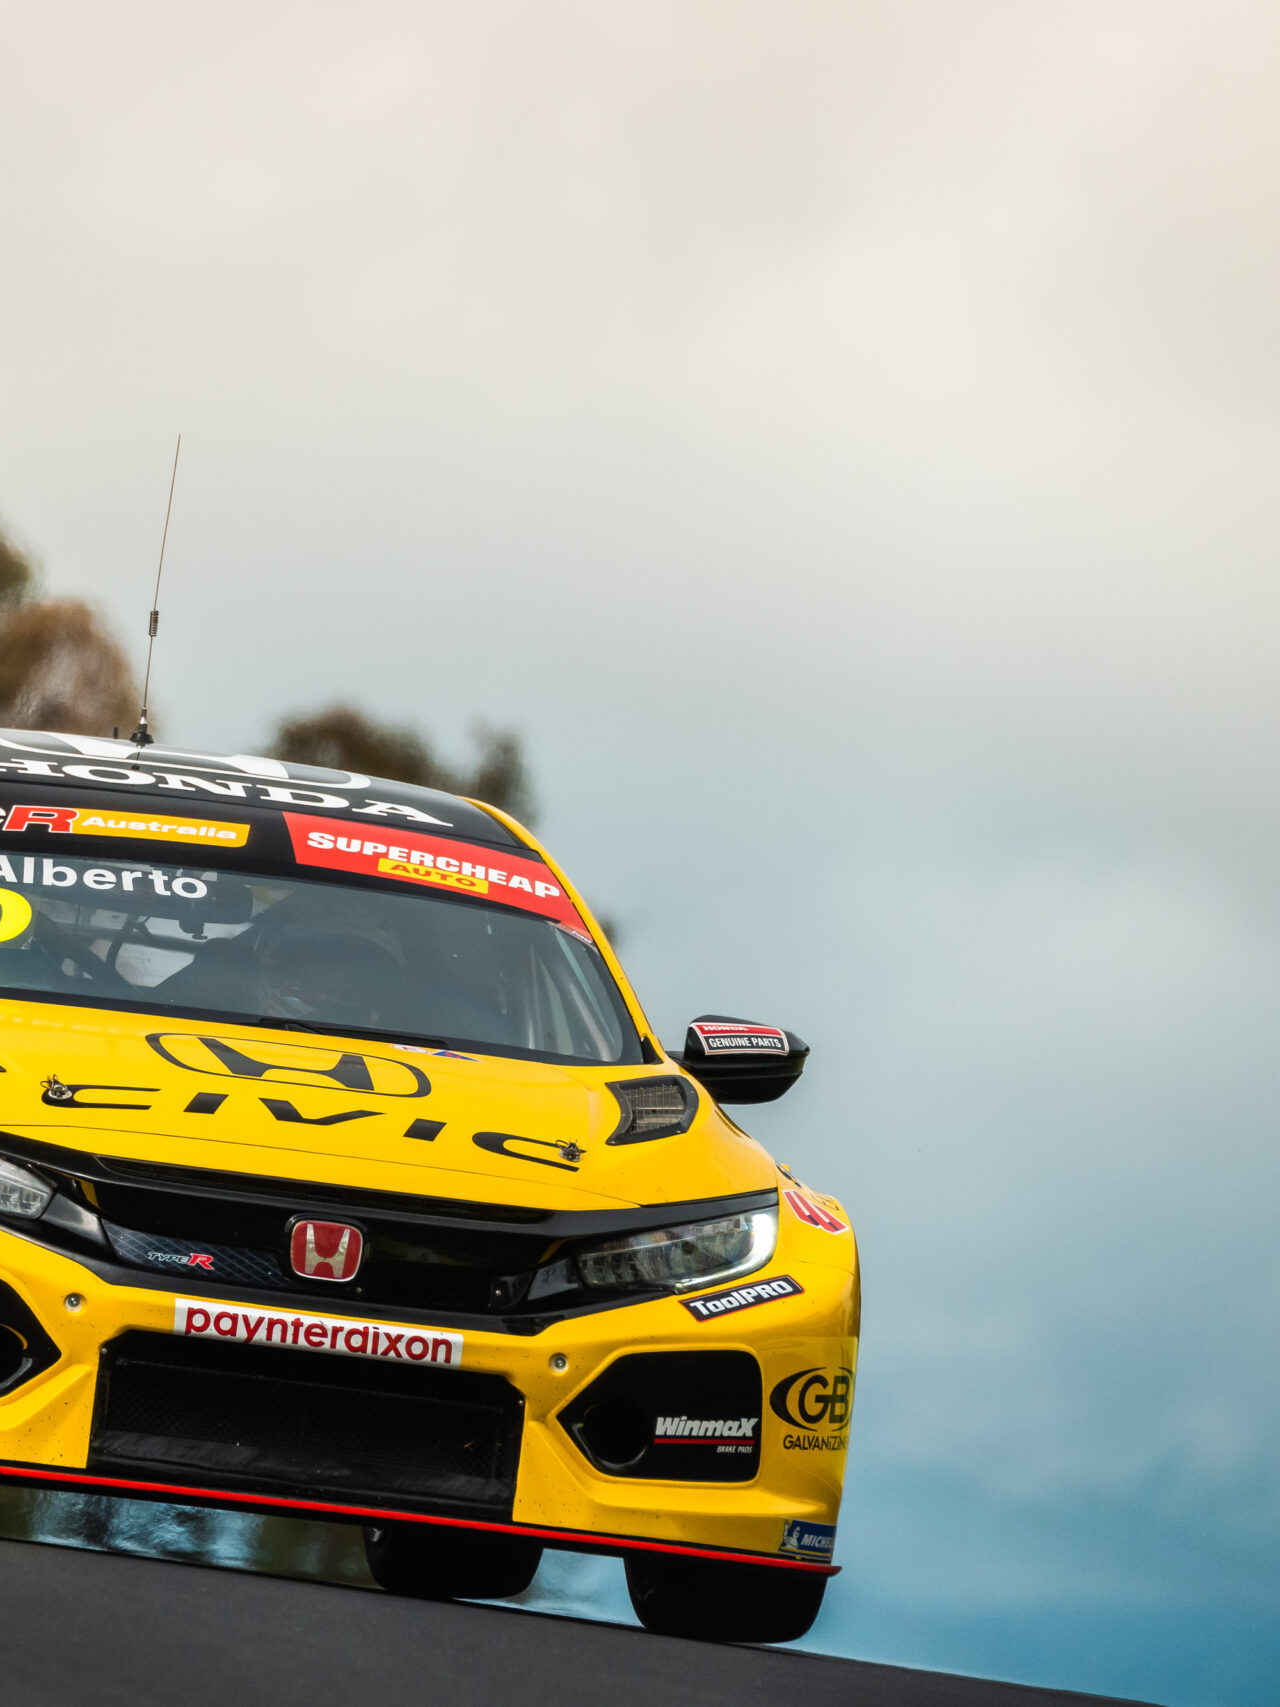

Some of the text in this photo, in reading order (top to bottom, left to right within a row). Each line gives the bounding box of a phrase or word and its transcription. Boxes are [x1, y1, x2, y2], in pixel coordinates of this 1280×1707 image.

[81, 815, 237, 840] Australia
[306, 831, 561, 898] SUPERCHEAP
[389, 863, 477, 888] AUTO
[709, 1037, 782, 1048] GENUINE PARTS
[41, 1084, 588, 1173] CIVIC
[147, 1251, 190, 1265] TYPE
[689, 1280, 794, 1316] ToolPRO
[184, 1306, 453, 1364] paynterdixon
[716, 1444, 753, 1454] BRAKE PADS
